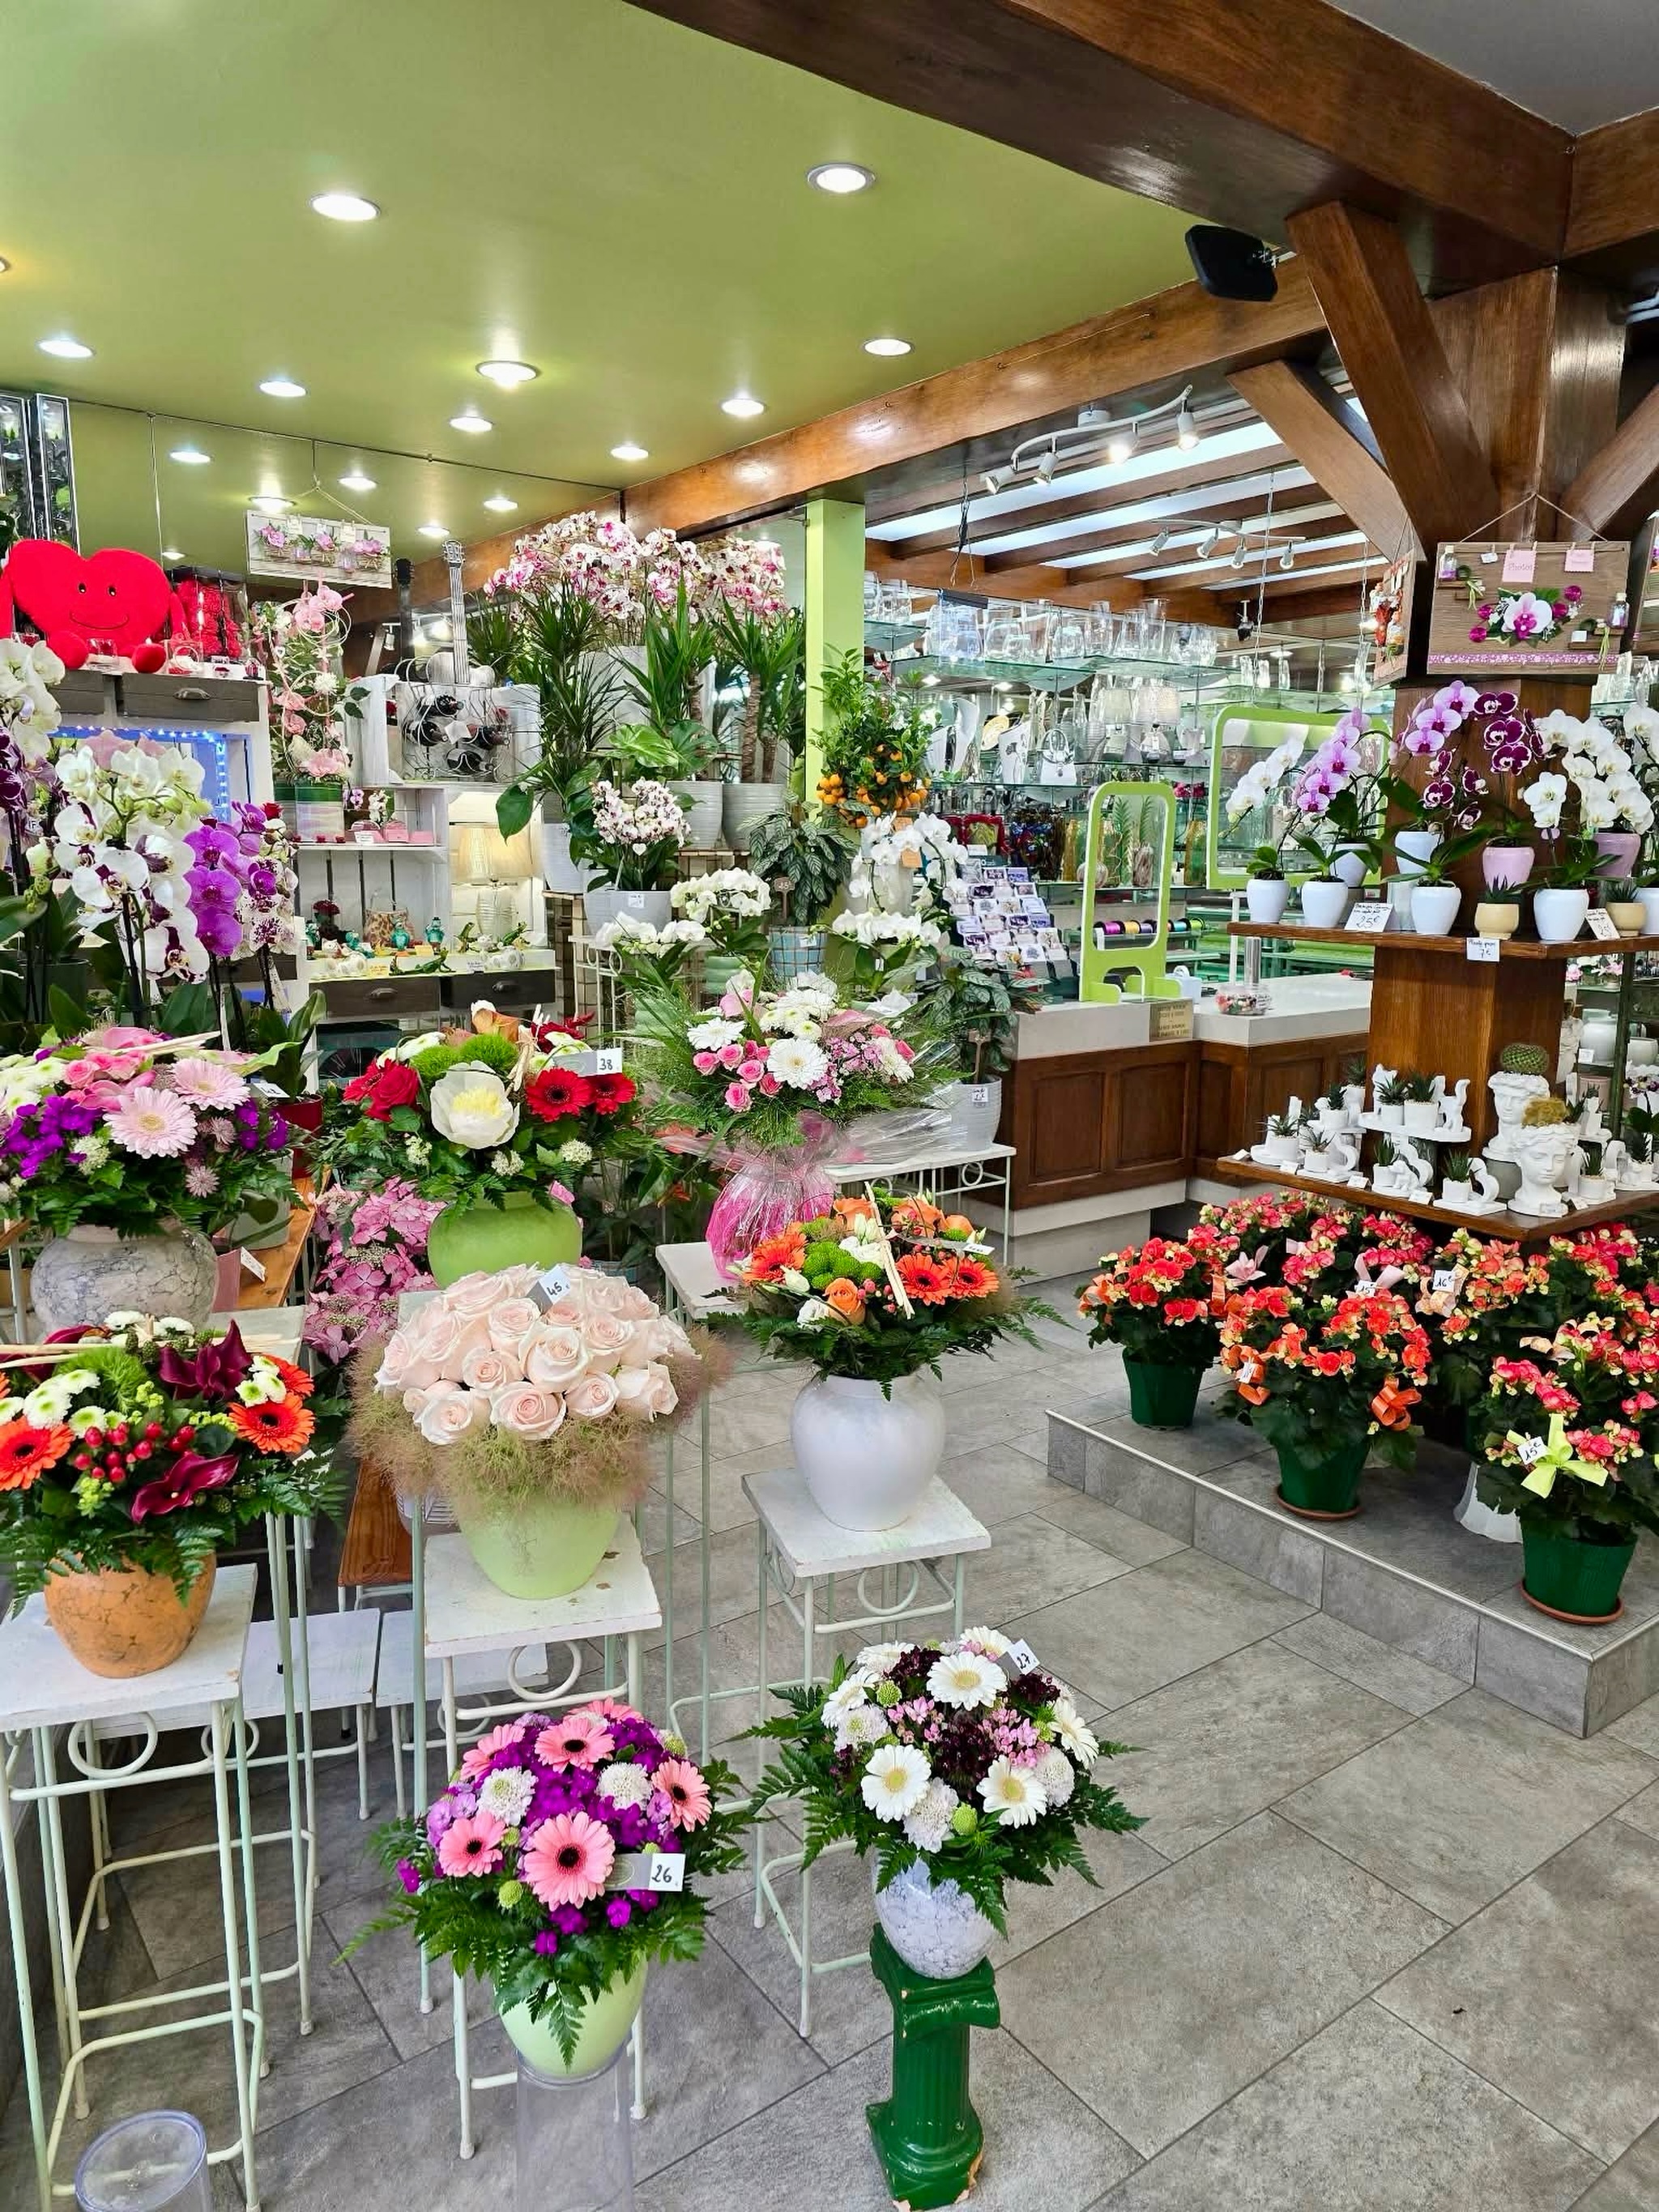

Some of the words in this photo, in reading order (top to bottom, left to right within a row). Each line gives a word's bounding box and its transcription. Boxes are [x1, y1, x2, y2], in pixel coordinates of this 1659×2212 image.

[1356, 915, 1380, 929] 25€
[599, 1058, 613, 1071] 38
[547, 1281, 563, 1296] 45
[1525, 1442, 1542, 1461] 15€
[651, 1863, 672, 1883] 26
